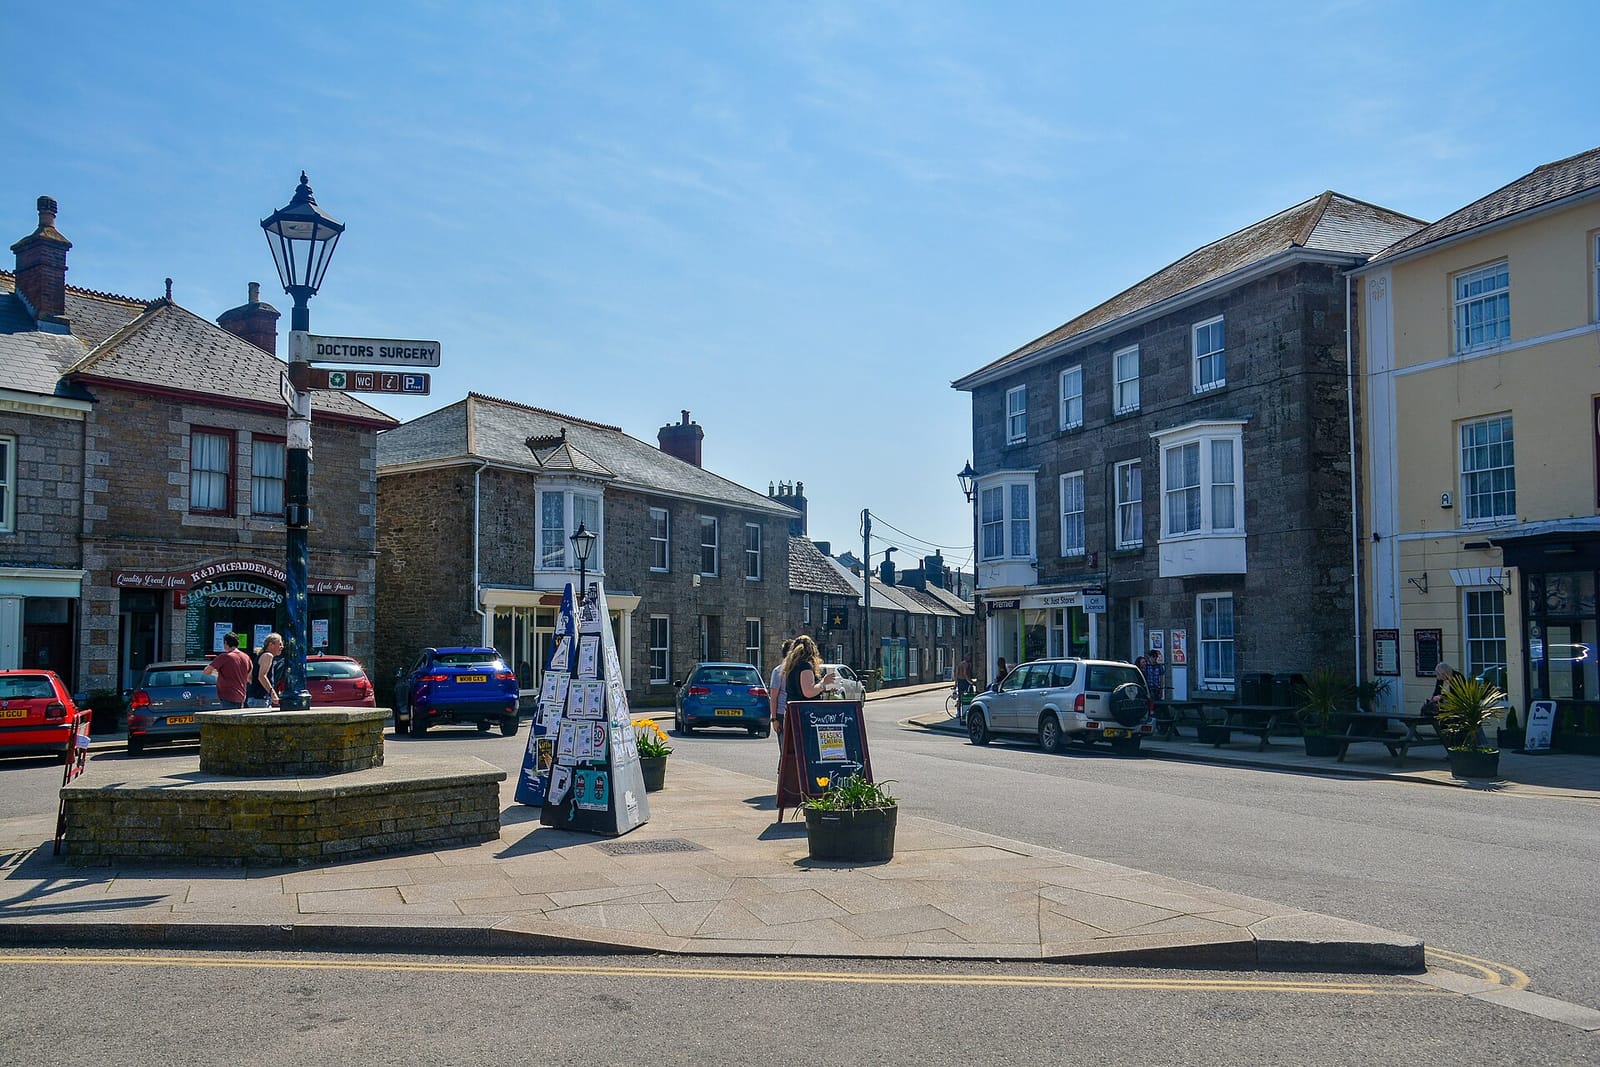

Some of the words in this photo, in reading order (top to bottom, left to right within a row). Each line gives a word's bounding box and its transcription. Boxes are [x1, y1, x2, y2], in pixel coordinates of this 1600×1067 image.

[317, 343, 374, 358] DOCTORS
[379, 346, 436, 361] SURGERY
[357, 376, 372, 387] WC
[405, 376, 415, 390] P
[116, 573, 142, 586] Quality
[143, 574, 165, 586] Local
[167, 576, 186, 587] Meats
[188, 583, 227, 601] LOCAL
[226, 581, 284, 604] BUTCHERS
[317, 582, 333, 592] Made
[332, 582, 354, 592] Pasties
[208, 596, 276, 609] Delicatessen
[992, 600, 1014, 609] Premier
[1051, 598, 1060, 606] Just
[1060, 596, 1075, 605] Stores
[6, 710, 22, 718] GCU
